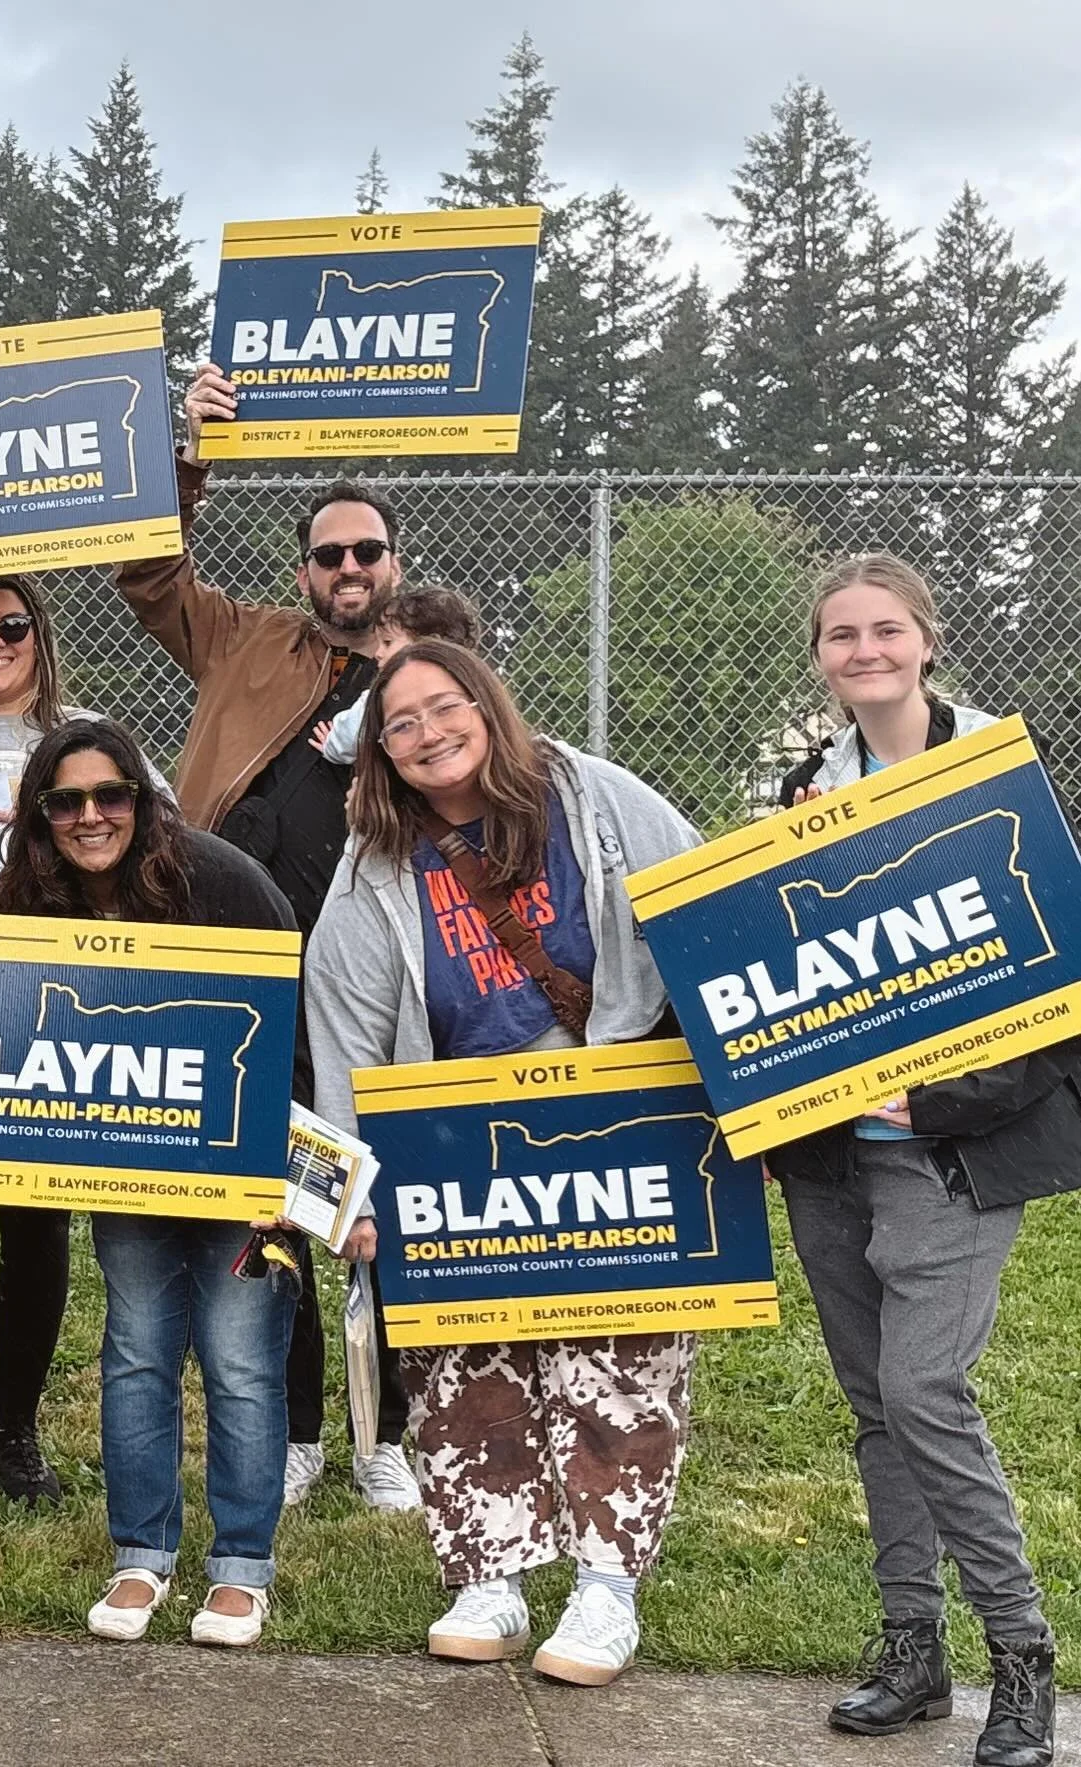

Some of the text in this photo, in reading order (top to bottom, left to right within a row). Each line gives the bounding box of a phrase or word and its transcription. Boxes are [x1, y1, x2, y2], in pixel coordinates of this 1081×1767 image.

[350, 225, 401, 241] VOTE
[231, 312, 455, 363] BLAYNE
[229, 363, 450, 385] SOLEYMANI-PEARSON
[233, 386, 447, 401] OR WASHINGTON COUNTY COMMISSIONER
[242, 426, 468, 441] DISTRICT 2 BLAYNEFOROREGON.COM
[20, 494, 104, 511] COMMISSIONER
[787, 801, 857, 839] VOTE
[73, 933, 135, 953] VOTE
[698, 876, 996, 1034] BLAYNE
[724, 937, 1008, 1060] SOLEYMANI-PEARSON
[732, 965, 1015, 1080] FOR WASHINGTON COUNTY COMMISSIONER
[512, 1064, 577, 1085] VOTE
[776, 1002, 1070, 1120] DISTRICT 2 BLAYNEFOROREGON.COM
[46, 1127, 97, 1139] COUNTY
[101, 1131, 199, 1146] COMMISSIONER
[15, 1174, 23, 1185] 2
[47, 1176, 225, 1198] BLAYNEFOROREGON.COM
[395, 1164, 673, 1235] BLAYNE
[404, 1224, 676, 1261] SOLEYMANI-PEARSON
[406, 1251, 678, 1279] FOR WASHINGTON COUNTY COMMISSIONER
[436, 1298, 716, 1325] DISTRICT 2 BLAYNEFOROREGON.COM
